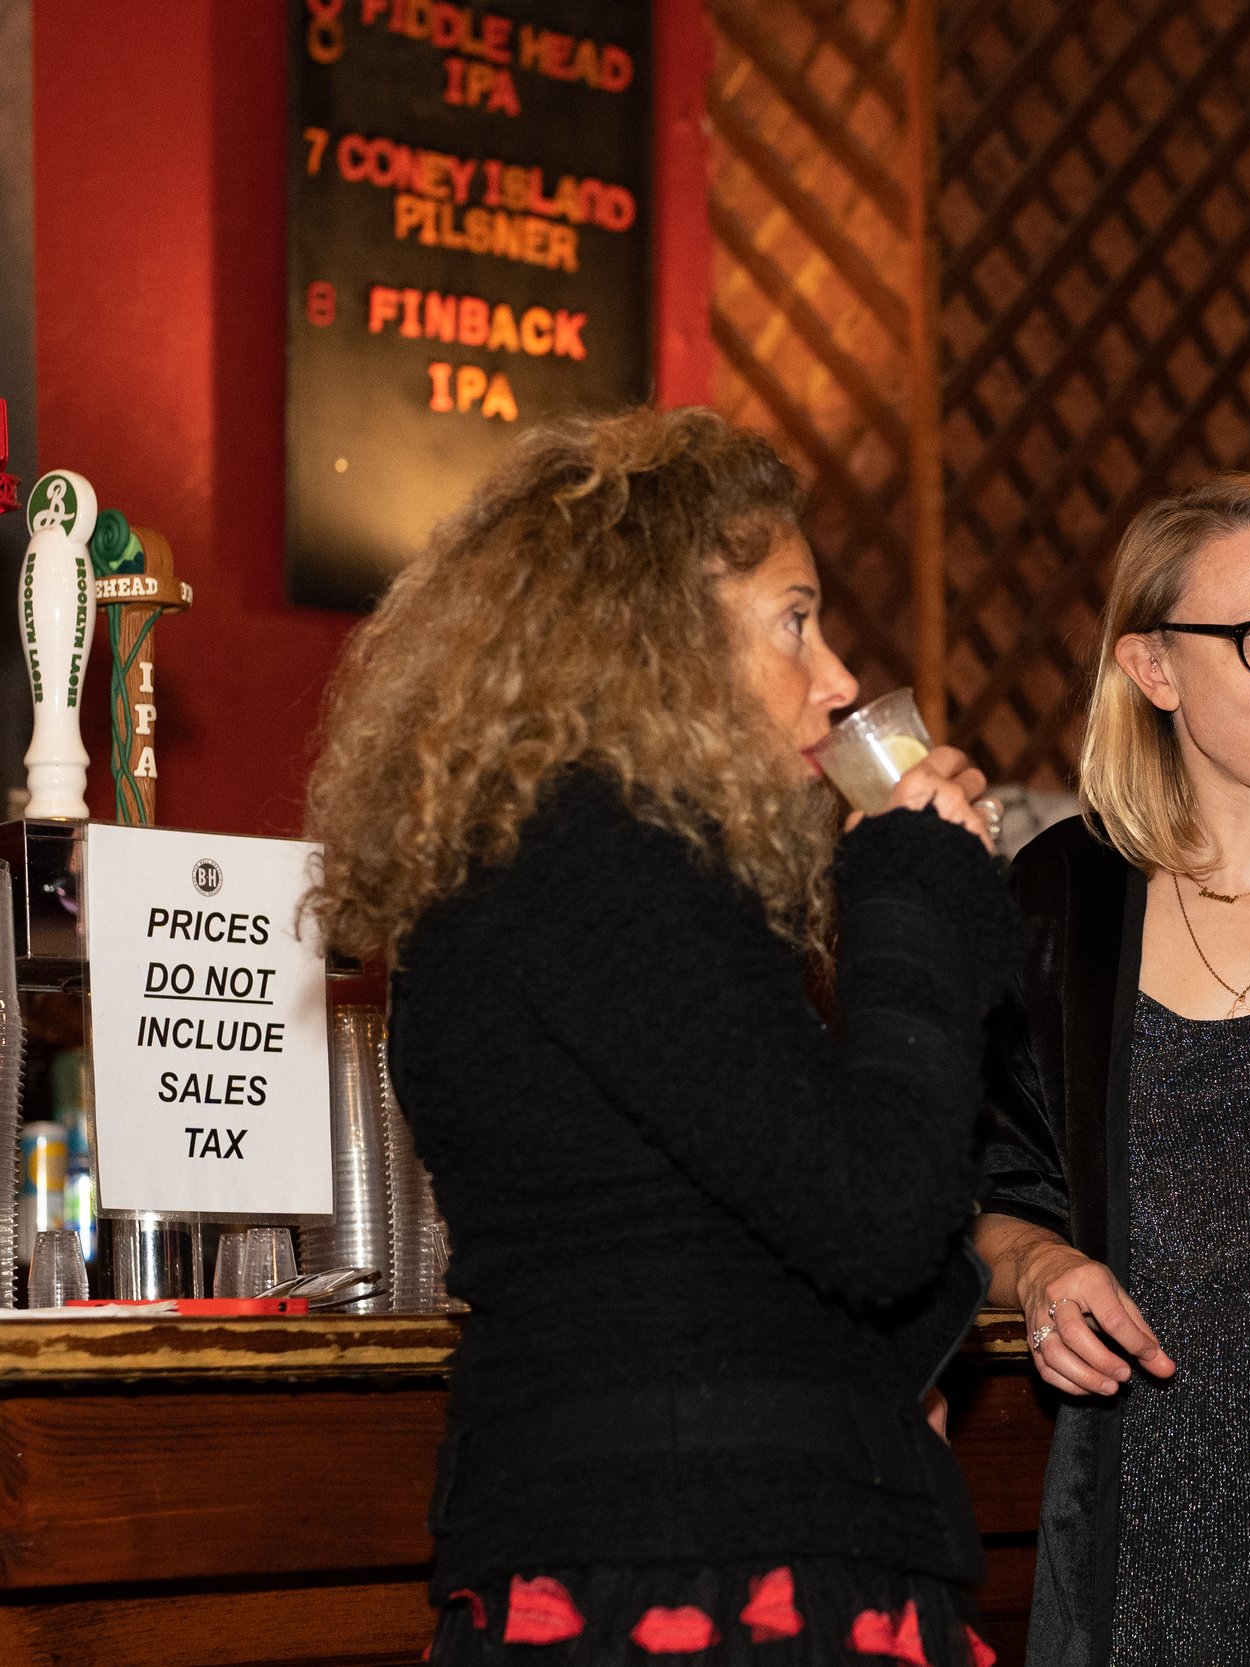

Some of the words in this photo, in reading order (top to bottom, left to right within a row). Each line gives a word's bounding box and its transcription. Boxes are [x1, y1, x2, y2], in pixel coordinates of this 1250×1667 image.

[443, 57, 521, 117] IPA
[519, 24, 634, 93] HEAD
[303, 127, 329, 176] 7
[337, 134, 476, 205] CONEY
[483, 159, 636, 232] ISLAND
[394, 194, 580, 273] PILSNER
[369, 285, 588, 361] FINBACK
[428, 362, 519, 421] IPA
[24, 552, 37, 644] BROOKLYN
[73, 557, 88, 649] BROOKLYN
[147, 907, 271, 945] PRICES
[145, 962, 195, 995] DO
[205, 966, 276, 999] NOT
[137, 1016, 285, 1053] INCLUDE
[158, 1072, 268, 1106] SALES
[184, 1127, 248, 1159] TAX
